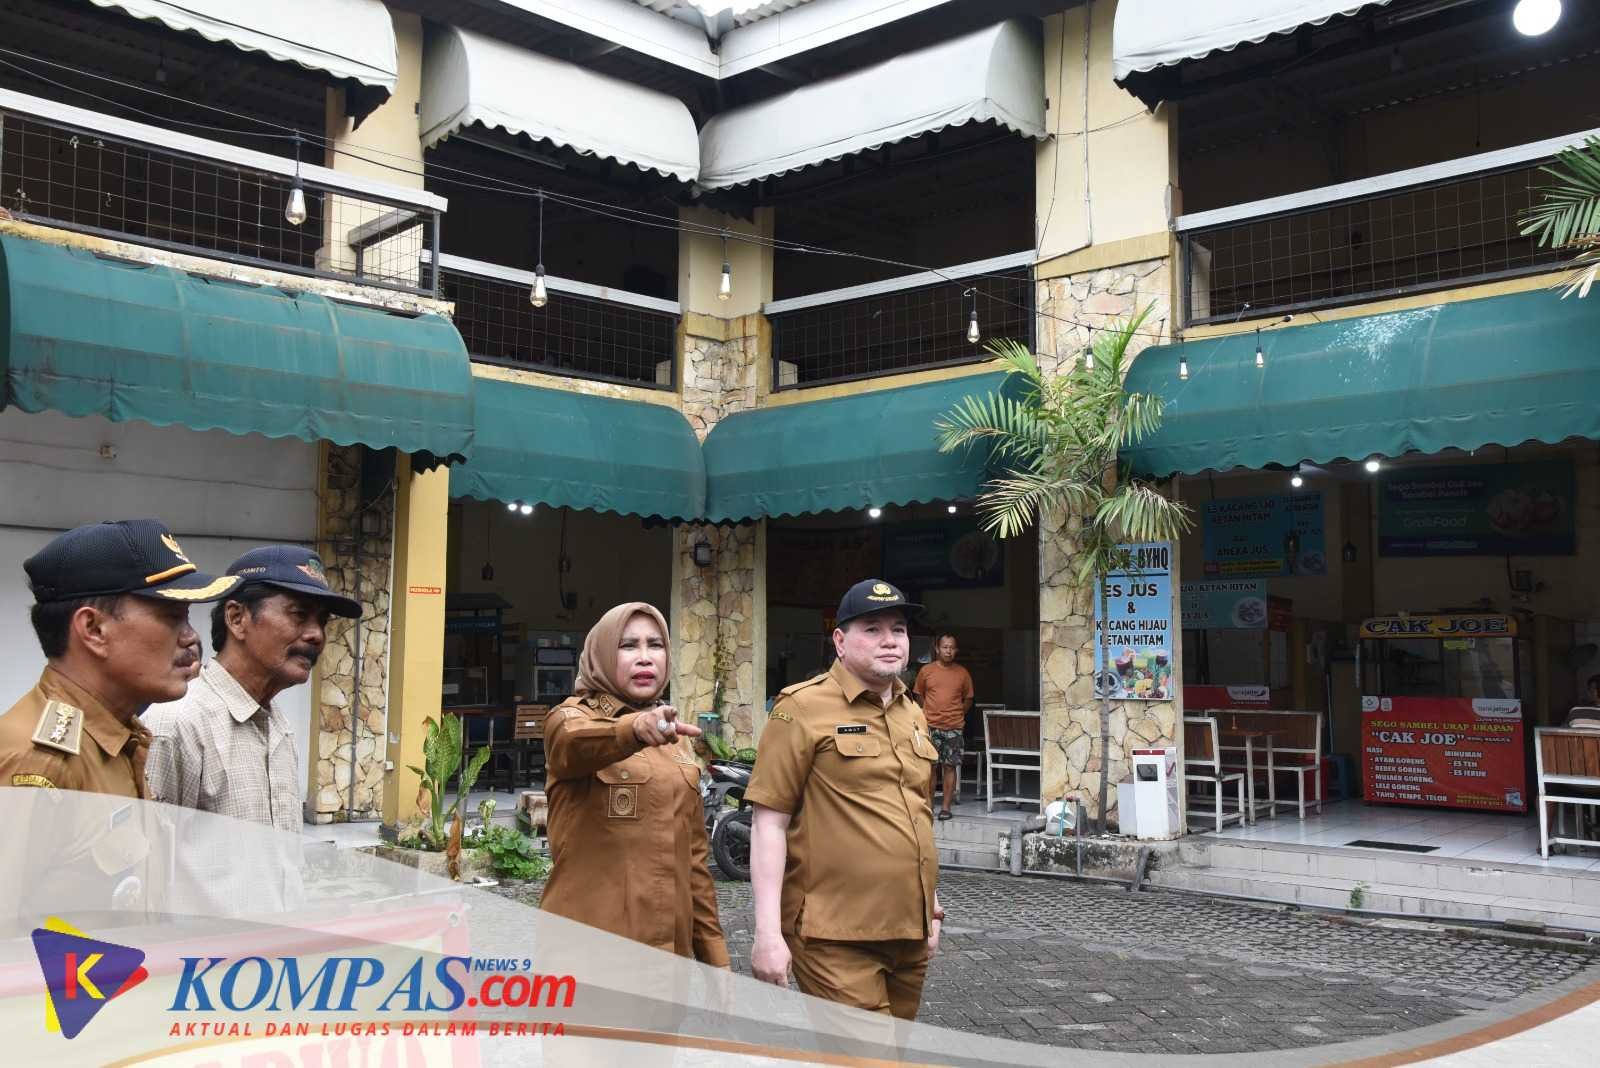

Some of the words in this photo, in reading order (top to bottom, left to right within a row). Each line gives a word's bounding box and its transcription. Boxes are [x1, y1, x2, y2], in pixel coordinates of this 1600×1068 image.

[1402, 516, 1467, 528] GrabFood
[1137, 548, 1169, 571] BYHQ
[1105, 585, 1122, 597] ES
[1127, 583, 1158, 597] JUS
[1127, 601, 1136, 614] &
[1138, 620, 1167, 631] HIJAU
[1364, 617, 1432, 634] CAK
[1438, 617, 1509, 633] JOE
[1133, 634, 1164, 646] HITAM
[1370, 720, 1397, 728] SEGO
[1445, 750, 1483, 759] MINUMAN
[1397, 758, 1426, 766] GORENG
[1398, 767, 1428, 775] GORENG
[1404, 776, 1434, 784] GORENG
[1392, 784, 1421, 792] GORENG
